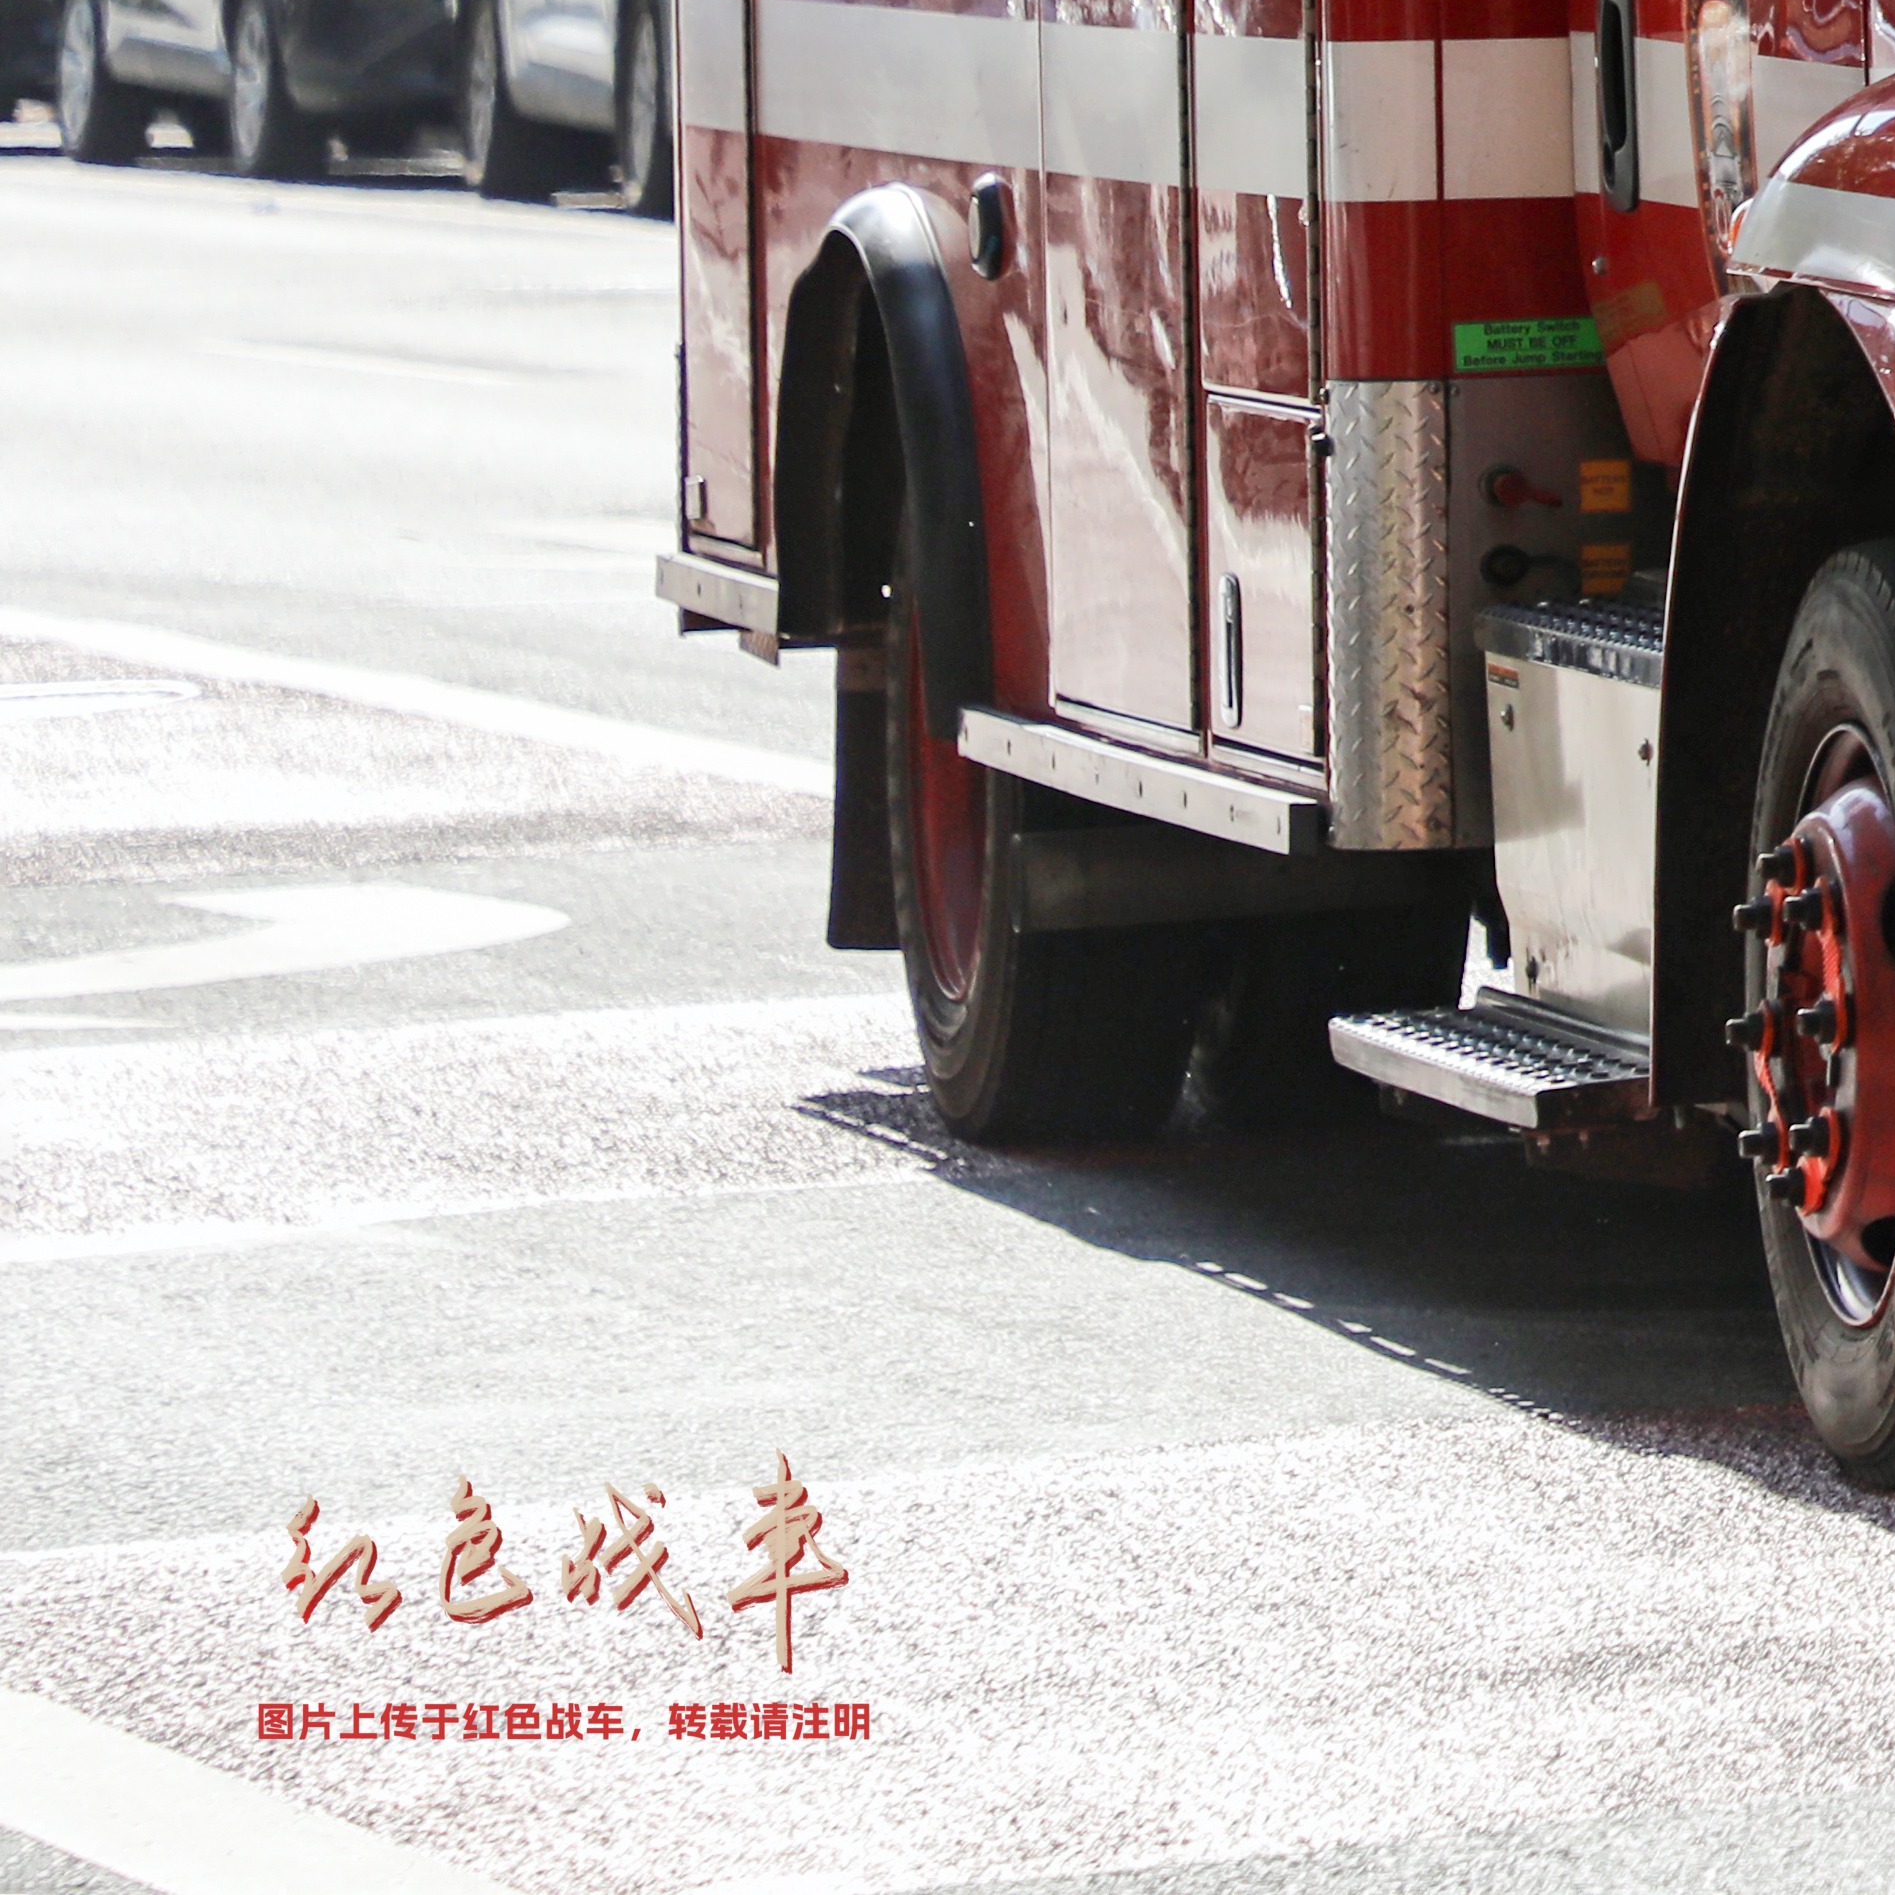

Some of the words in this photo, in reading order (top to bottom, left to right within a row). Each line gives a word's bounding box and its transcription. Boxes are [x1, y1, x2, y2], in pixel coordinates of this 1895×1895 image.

[1483, 321, 1530, 336] Battery
[1537, 320, 1580, 333] Switch
[1487, 337, 1523, 350] MUST
[1529, 336, 1546, 348] BE
[1552, 334, 1577, 347] OFF
[1463, 355, 1506, 366] Before
[1512, 353, 1546, 365] Jump
[1552, 350, 1602, 363] Starting
